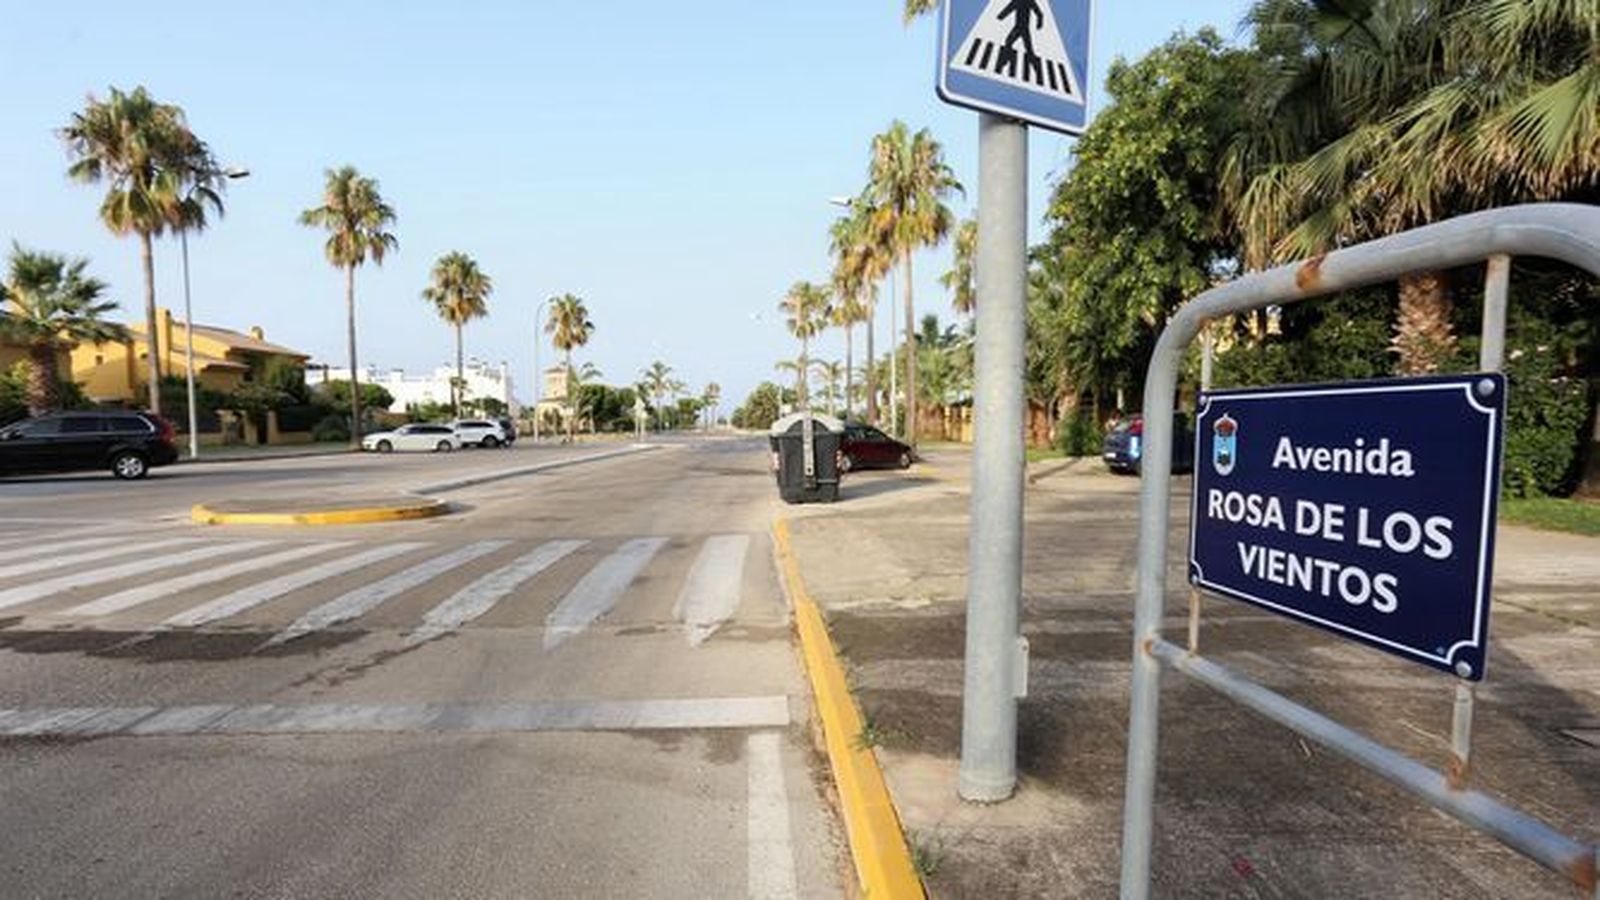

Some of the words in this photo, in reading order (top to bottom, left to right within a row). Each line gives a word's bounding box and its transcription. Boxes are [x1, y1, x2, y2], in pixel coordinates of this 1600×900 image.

[1272, 436, 1415, 477] Avenida
[1208, 488, 1286, 532] ROSA
[1295, 499, 1345, 542] DE
[1357, 507, 1453, 560] LOS
[1237, 541, 1398, 613] VIENTOS
